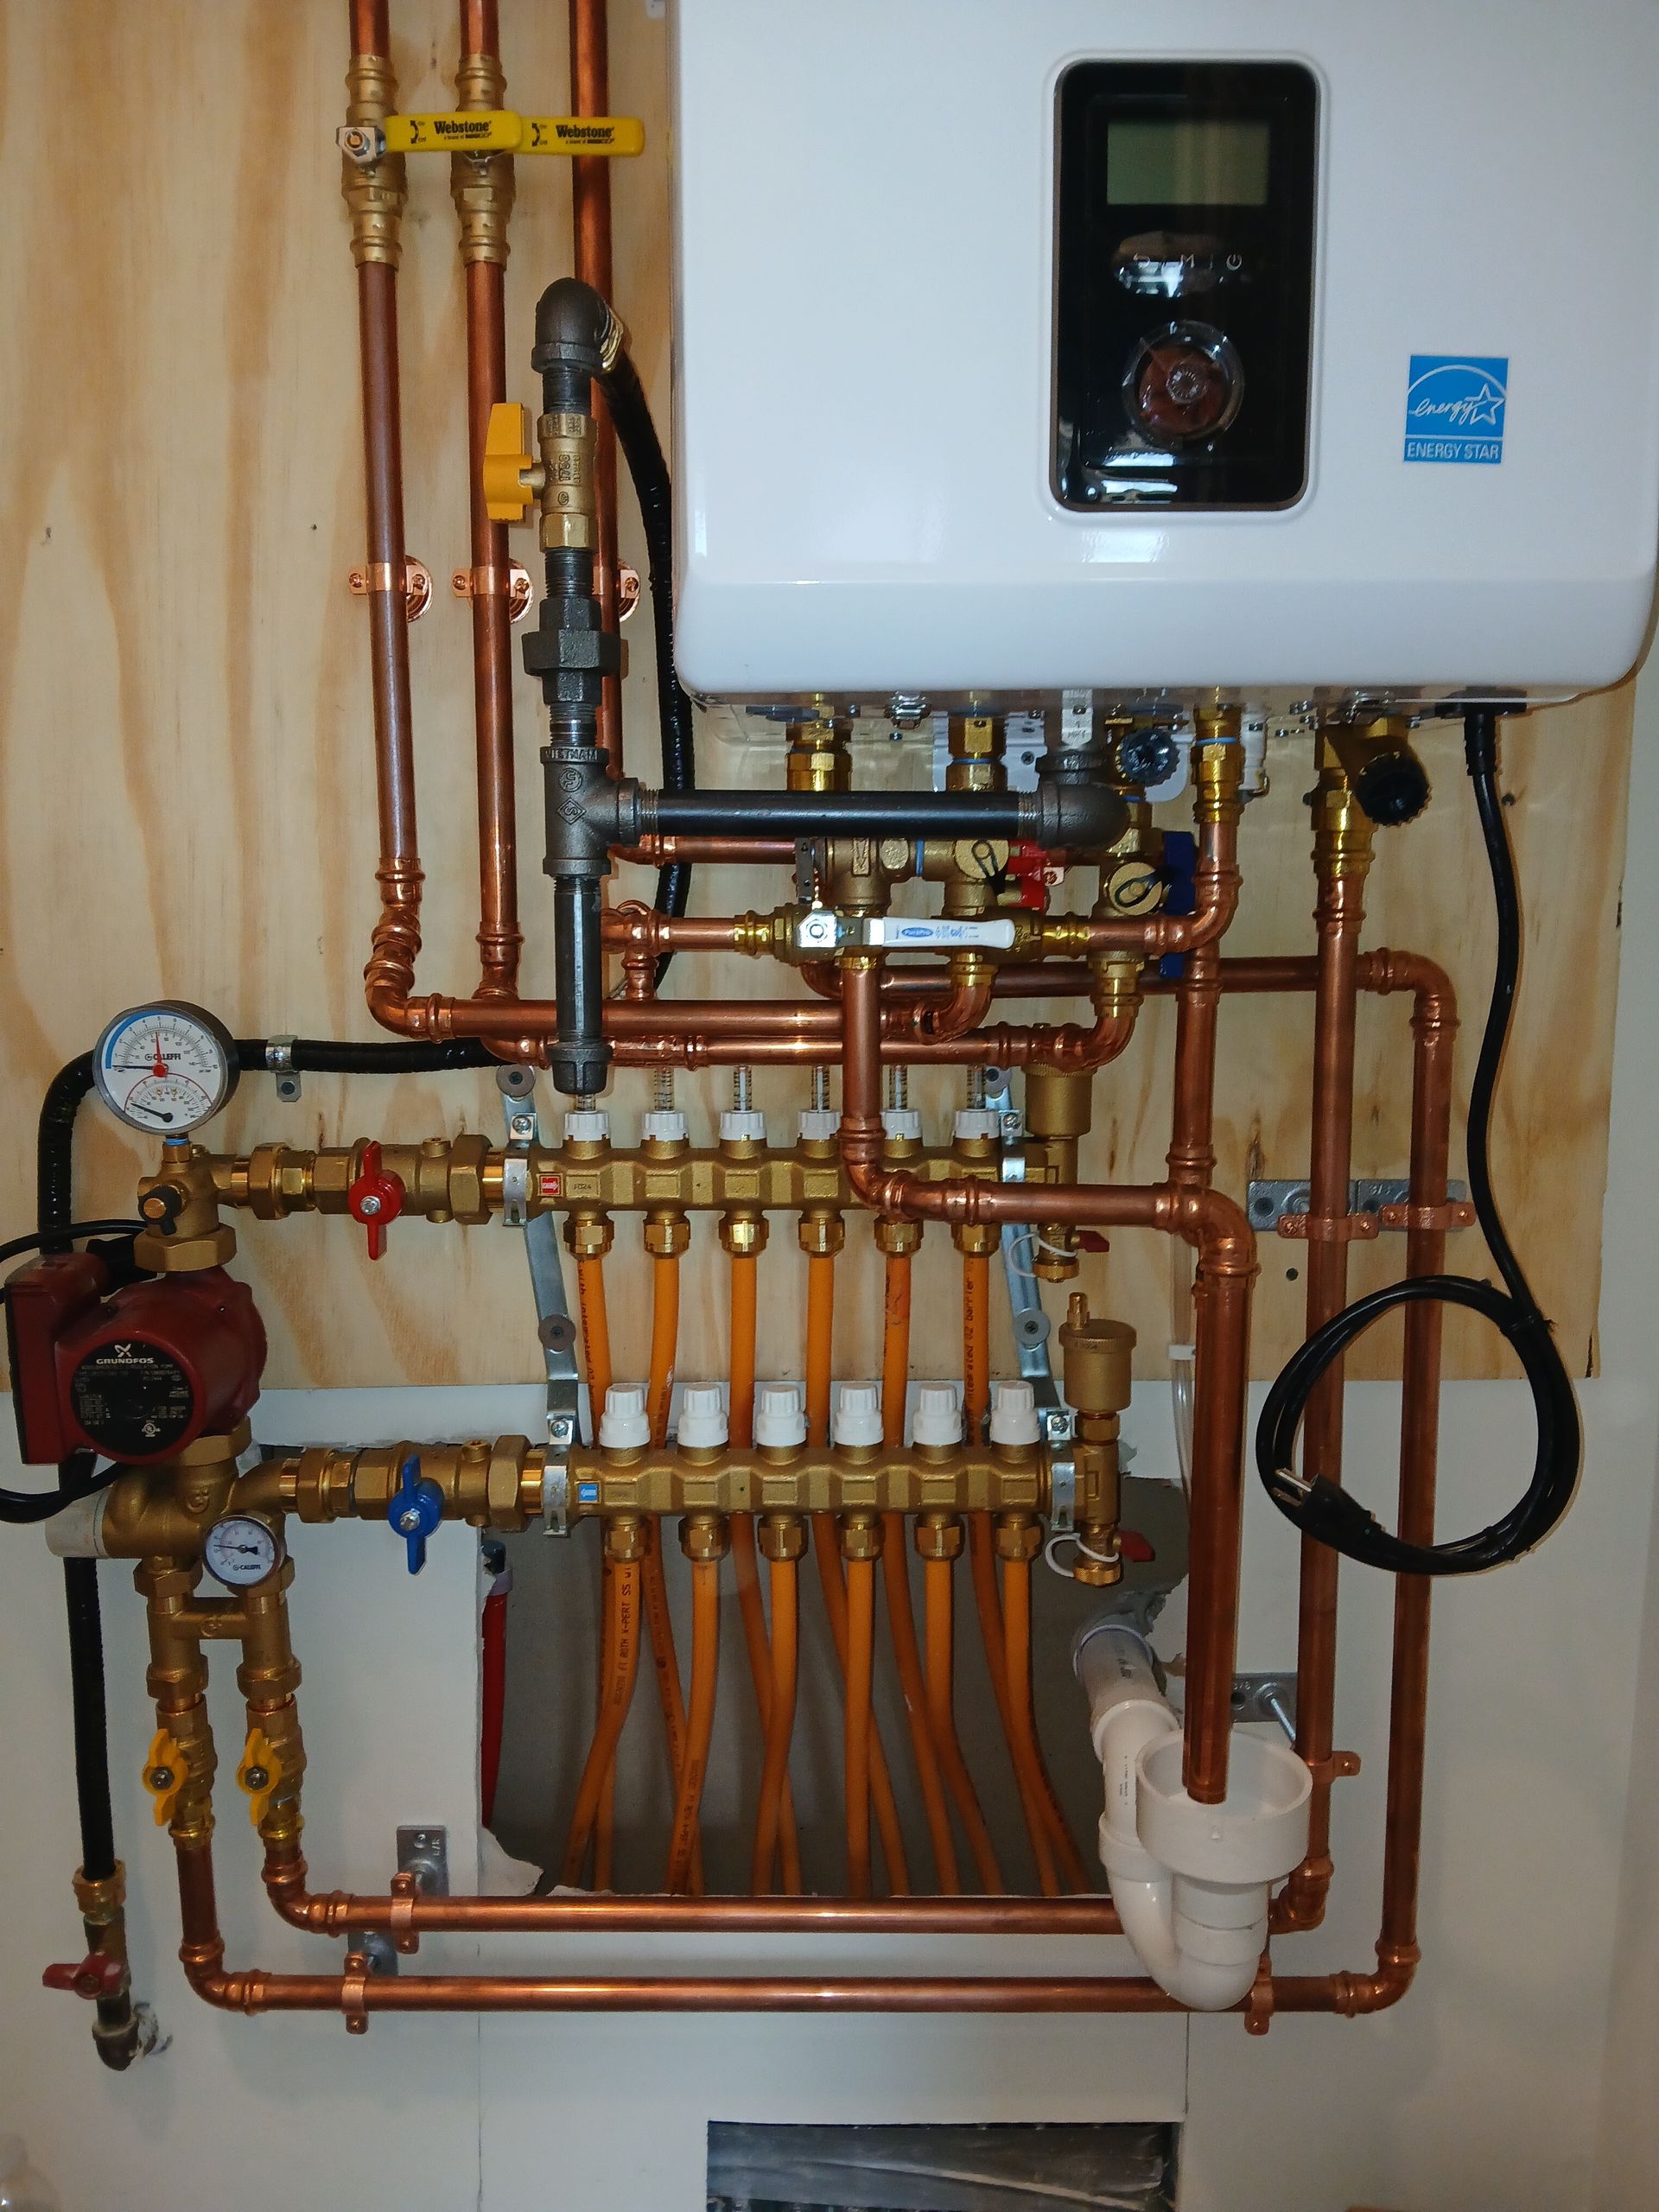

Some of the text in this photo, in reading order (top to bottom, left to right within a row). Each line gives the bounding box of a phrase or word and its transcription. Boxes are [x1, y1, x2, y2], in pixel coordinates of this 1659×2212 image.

[434, 120, 490, 135] Webstone
[556, 124, 613, 138] Webstone
[1413, 398, 1474, 426] energy
[1407, 442, 1499, 461] ENERGY STAR
